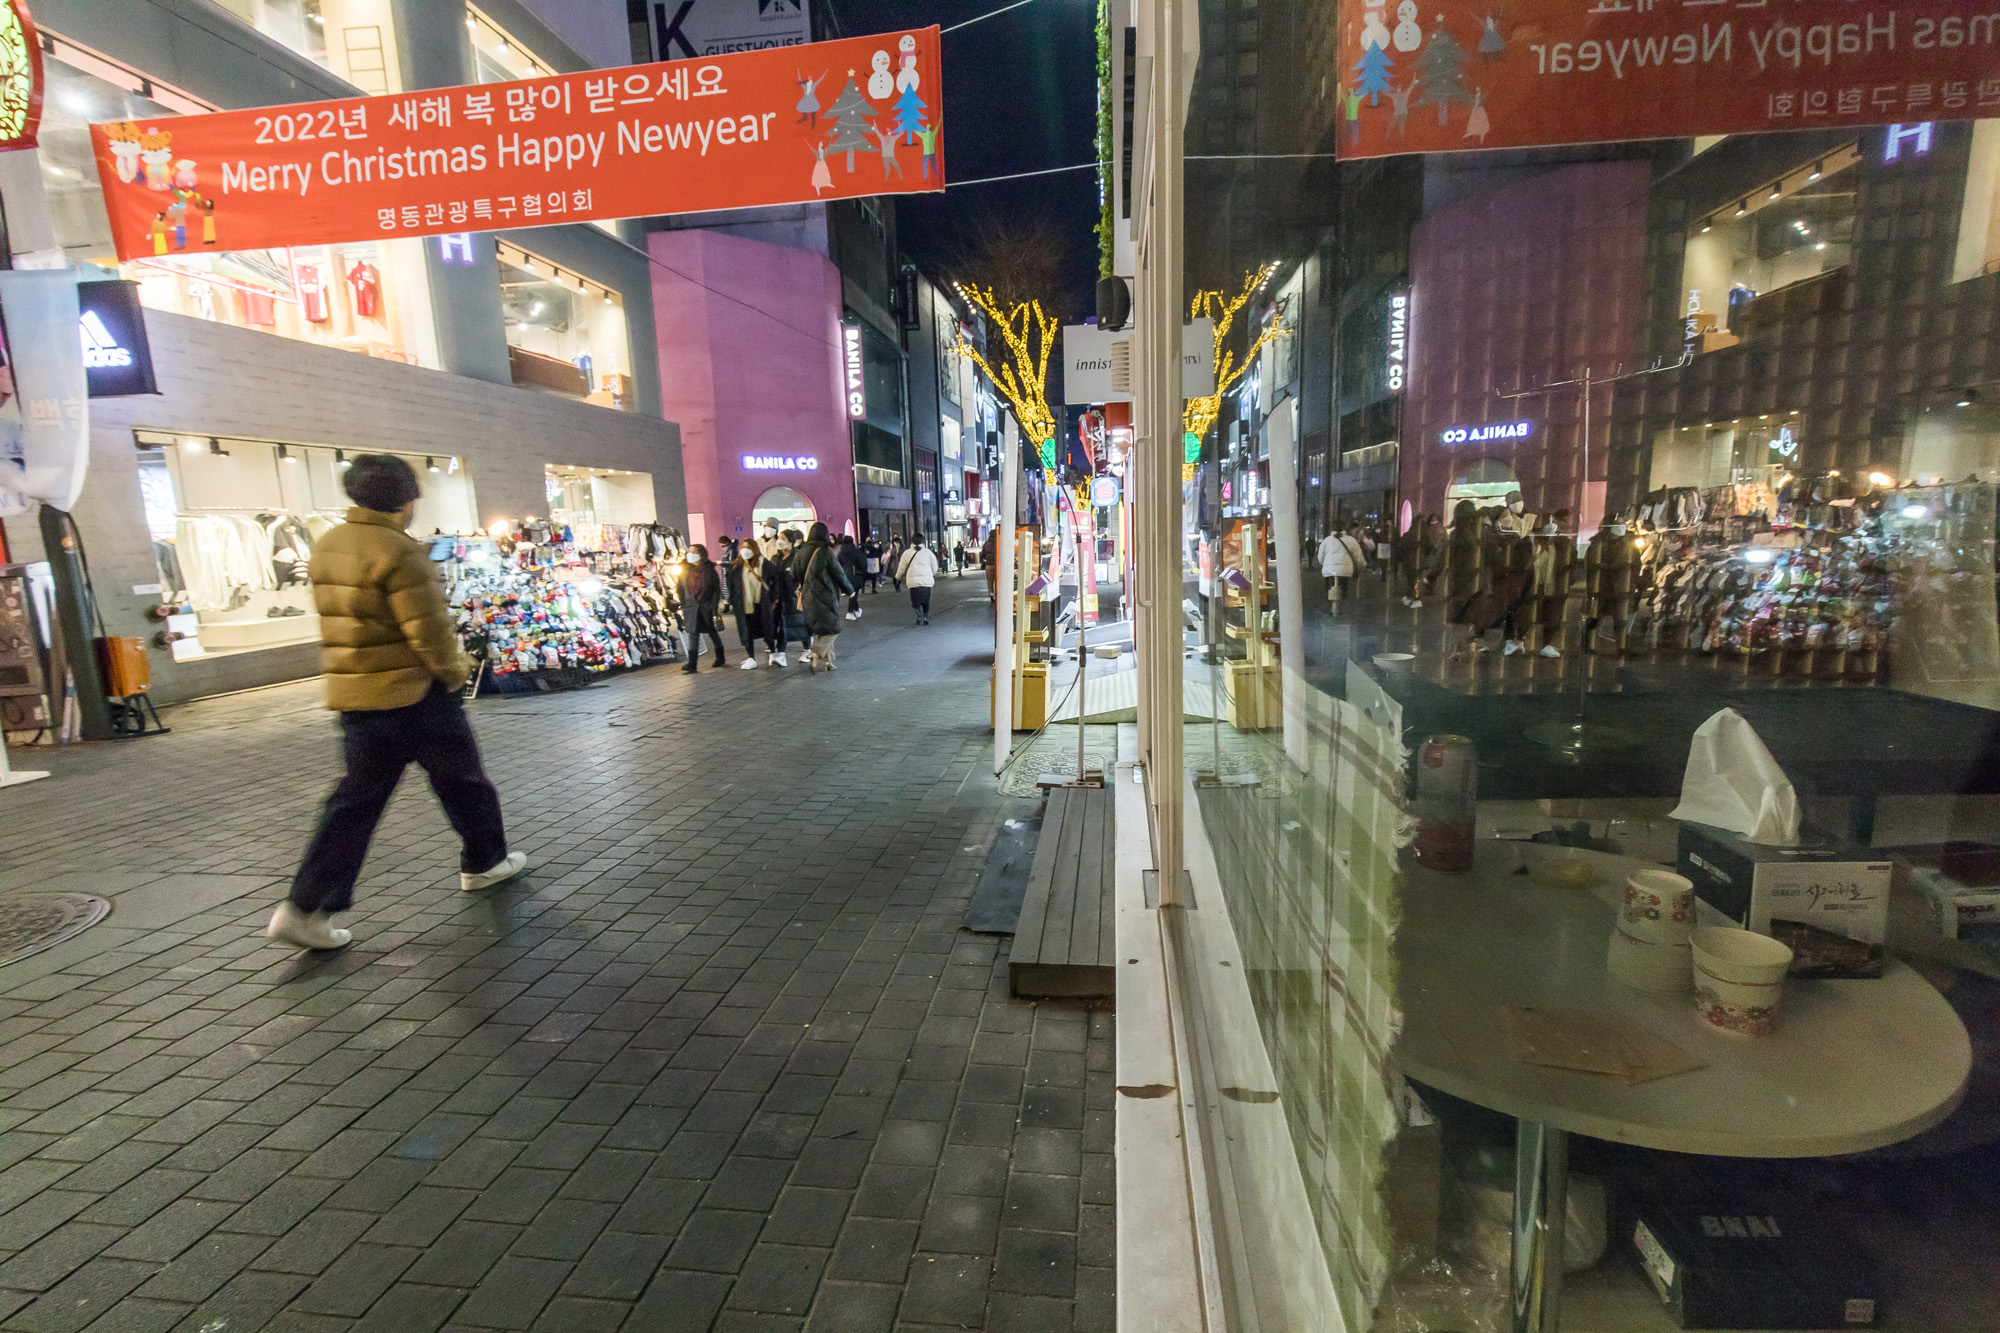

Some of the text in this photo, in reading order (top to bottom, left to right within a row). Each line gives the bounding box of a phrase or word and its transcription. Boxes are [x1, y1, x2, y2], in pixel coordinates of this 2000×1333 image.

[255, 65, 728, 145] 2022년 새해 복 많이 받으세요
[222, 112, 777, 196] Merry Christmas Happy Newyear
[378, 188, 593, 230] 명동관광특구협의회
[845, 329, 864, 416] BANILA CO
[744, 456, 818, 470] BANILA CO
